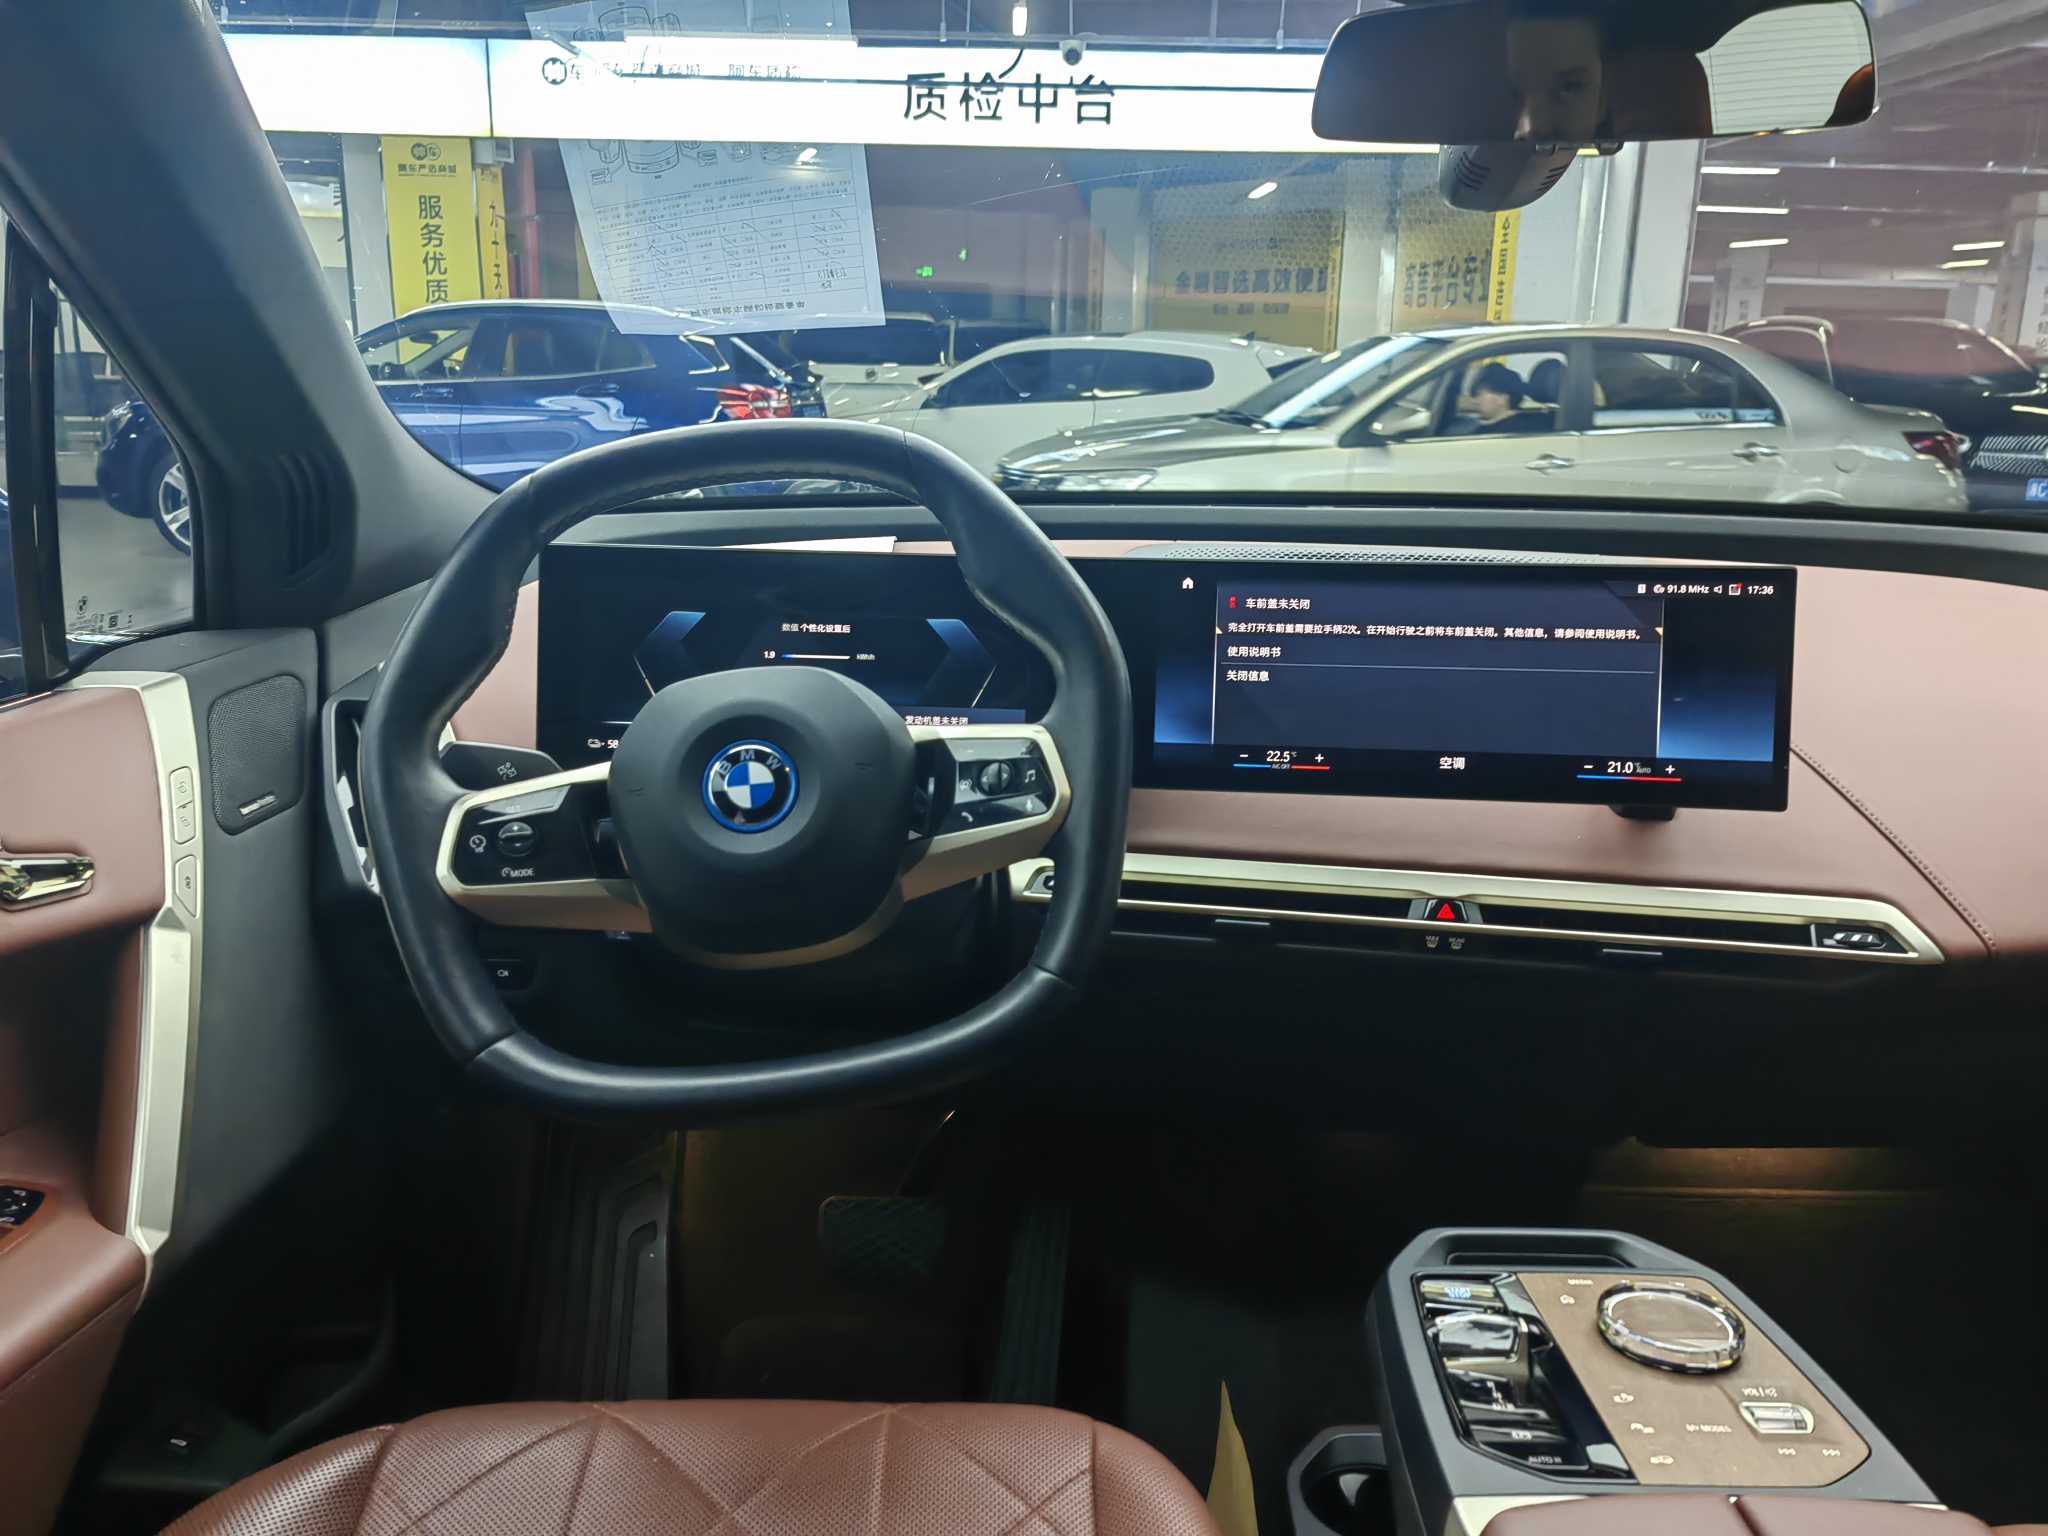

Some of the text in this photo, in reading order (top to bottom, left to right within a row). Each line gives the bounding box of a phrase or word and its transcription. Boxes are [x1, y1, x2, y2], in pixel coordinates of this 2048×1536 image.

[903, 72, 1115, 125] 质检中台
[418, 194, 449, 304] 服务优质
[1667, 584, 1710, 594] 91.8 MHz
[1747, 585, 1774, 595] 17:36
[1245, 598, 1311, 610] 车前盖未关闭
[1226, 646, 1282, 658] 使用说明书
[1226, 670, 1270, 683] 关闭信息
[717, 750, 782, 776] BMW
[1439, 756, 1466, 770] 空调
[510, 867, 535, 878] MODE
